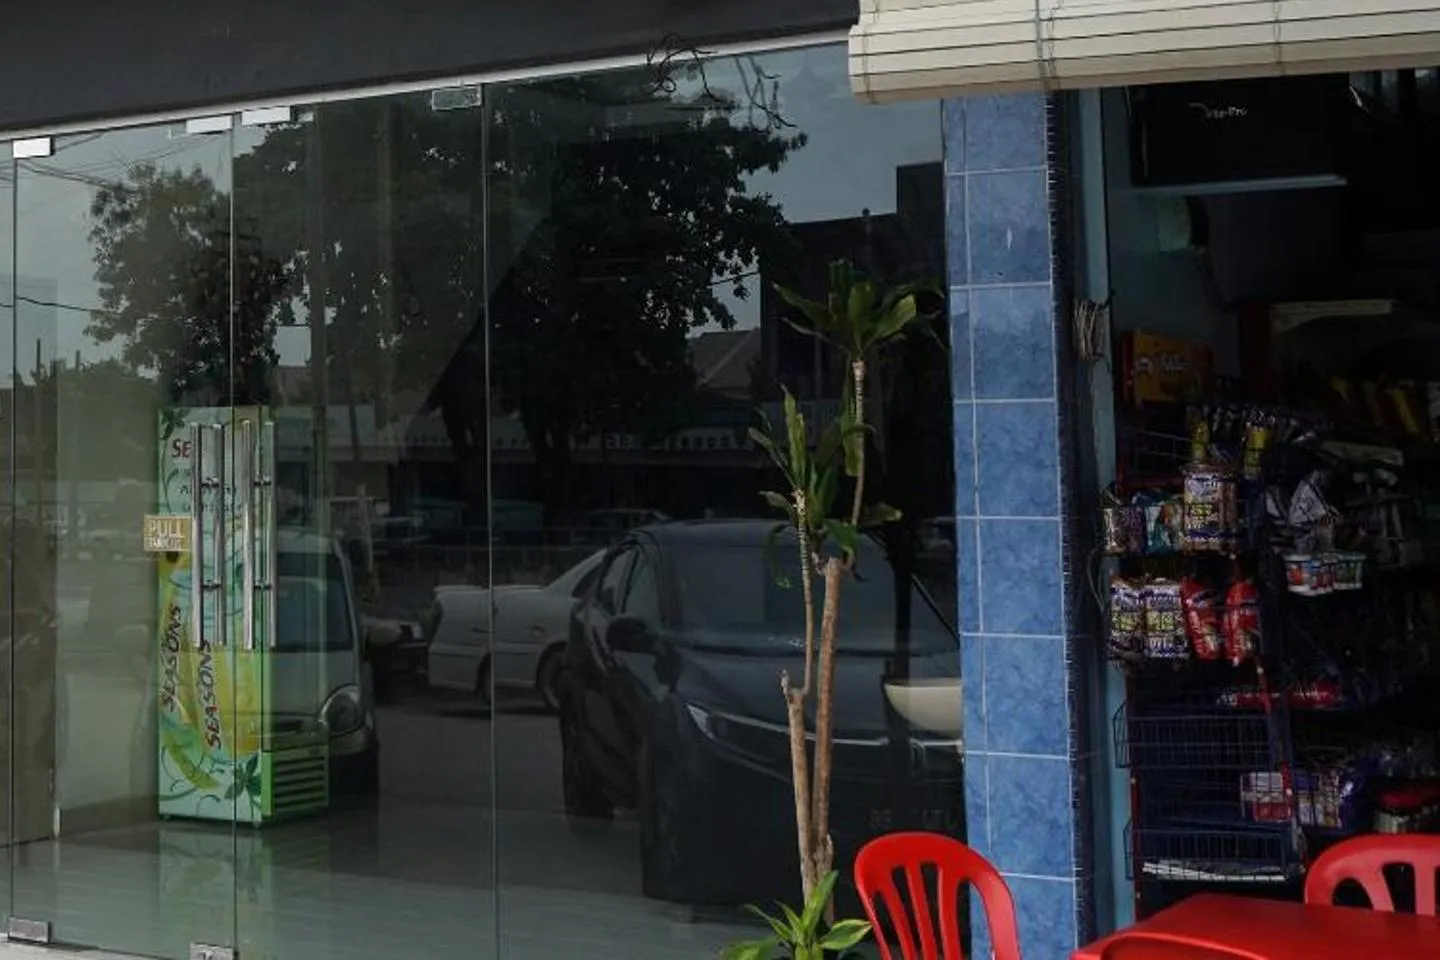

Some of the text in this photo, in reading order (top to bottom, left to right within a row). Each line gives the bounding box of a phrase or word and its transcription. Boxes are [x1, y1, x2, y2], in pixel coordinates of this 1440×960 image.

[148, 519, 186, 538] PULL
[161, 606, 181, 713] SEASONS
[199, 639, 221, 751] SEASONS
